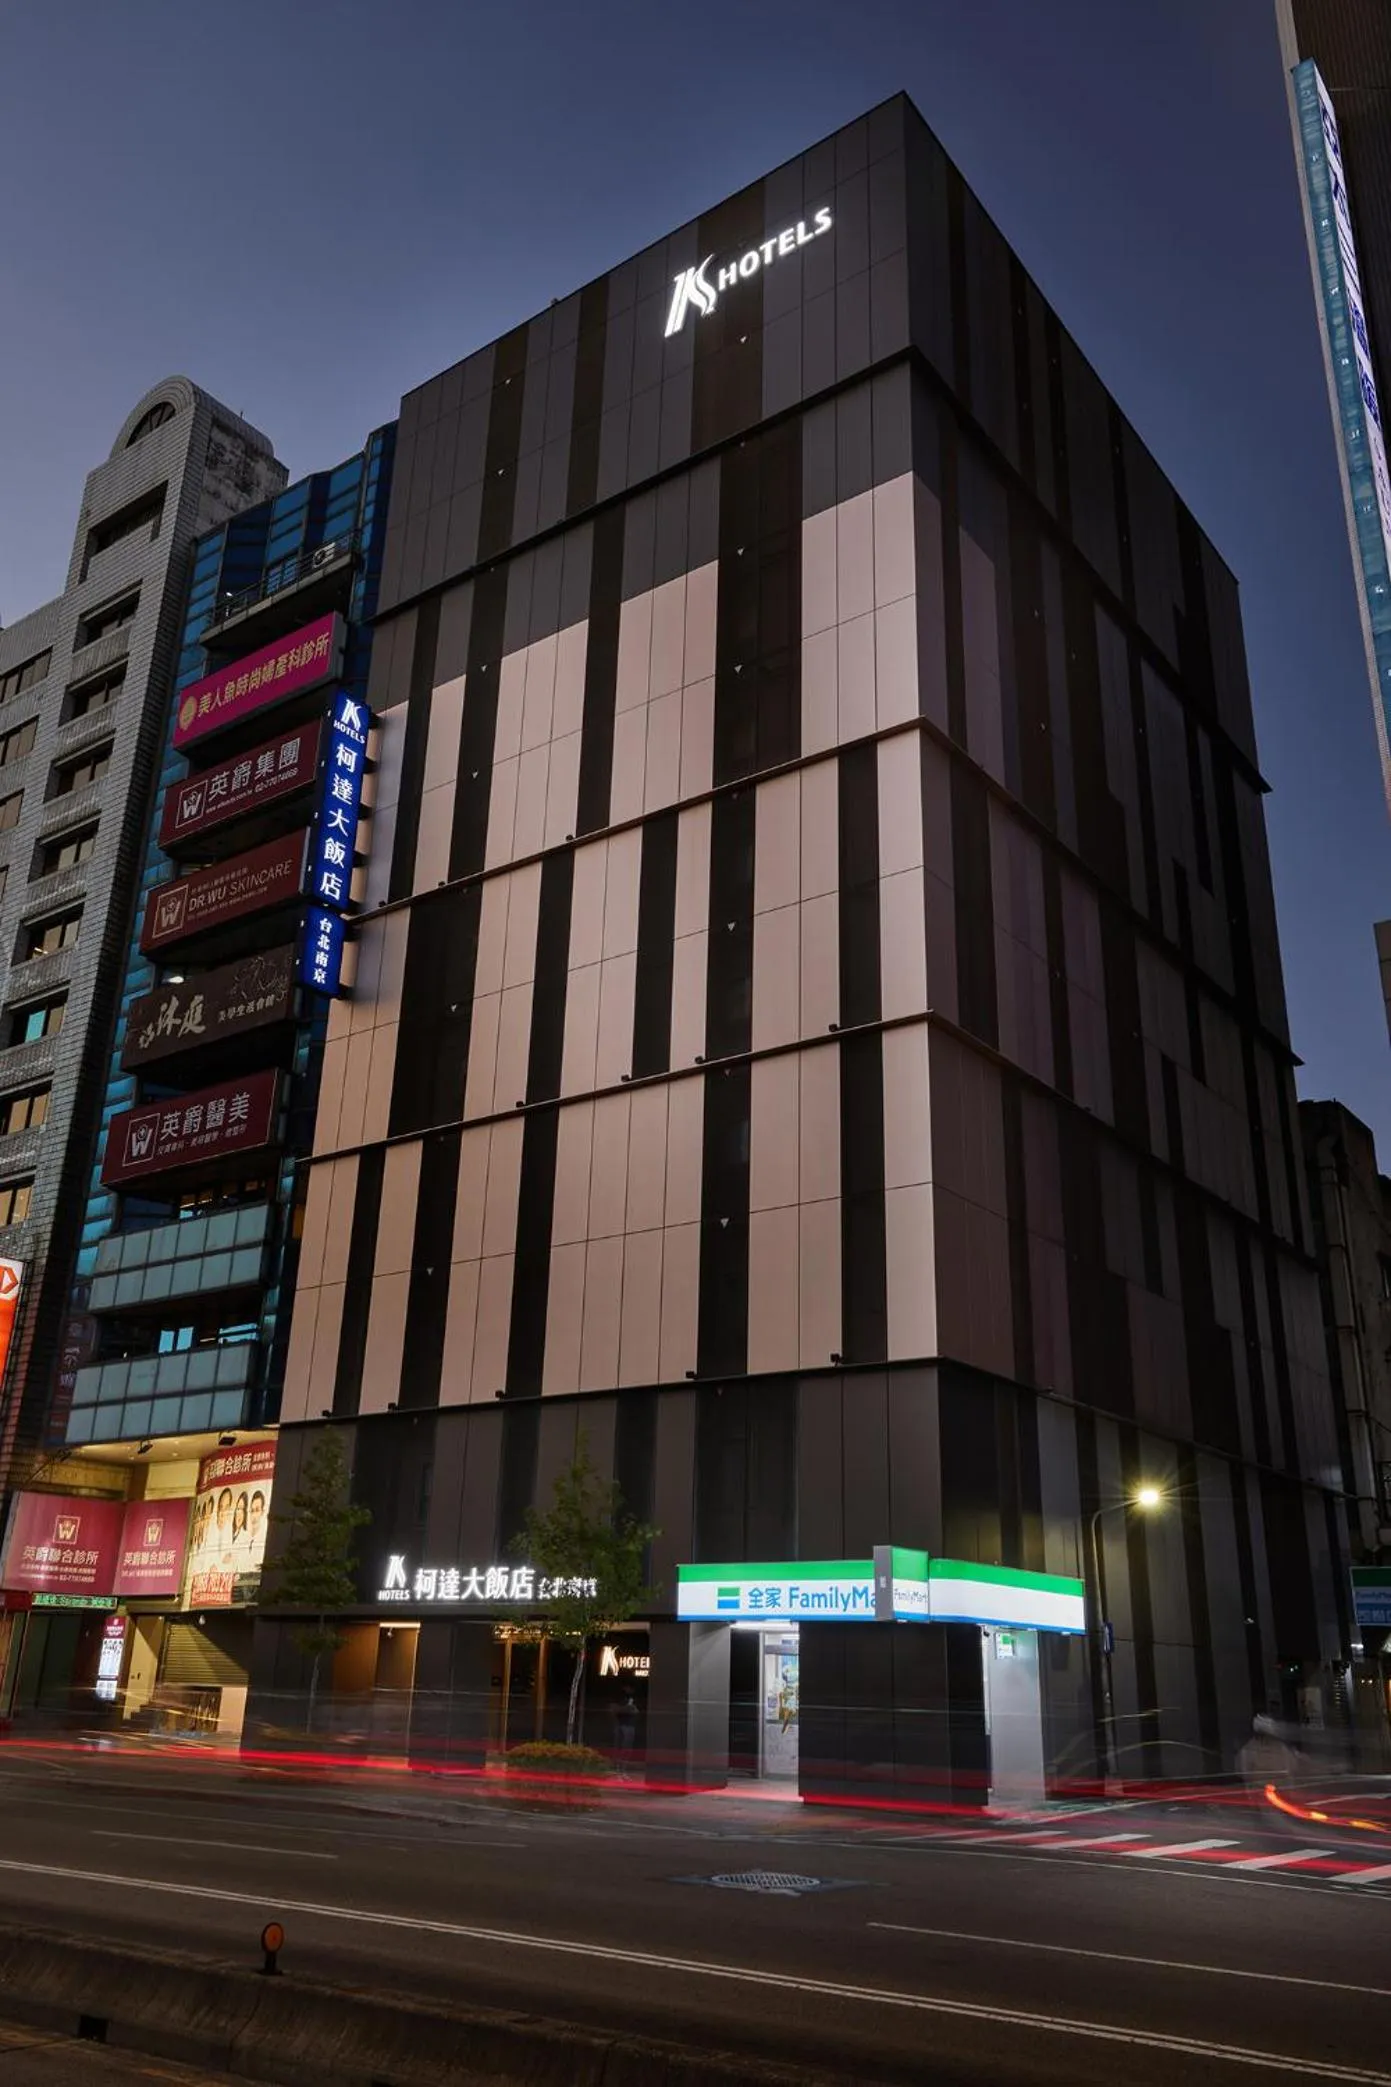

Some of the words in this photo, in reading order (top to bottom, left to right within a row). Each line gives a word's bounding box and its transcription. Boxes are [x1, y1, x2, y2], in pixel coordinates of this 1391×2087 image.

[718, 205, 833, 292] HOTELS
[333, 721, 366, 745] HOTELS
[207, 737, 301, 801] 英爵集團
[320, 742, 358, 901] 柯達大飯店
[229, 859, 293, 896] SKINCARE
[313, 917, 333, 985] 台北南京
[159, 1091, 251, 1141] 英爵醫美
[378, 1589, 410, 1601] HOTELS
[414, 1566, 536, 1600] 柯達大飯店
[747, 1587, 782, 1609] 全家
